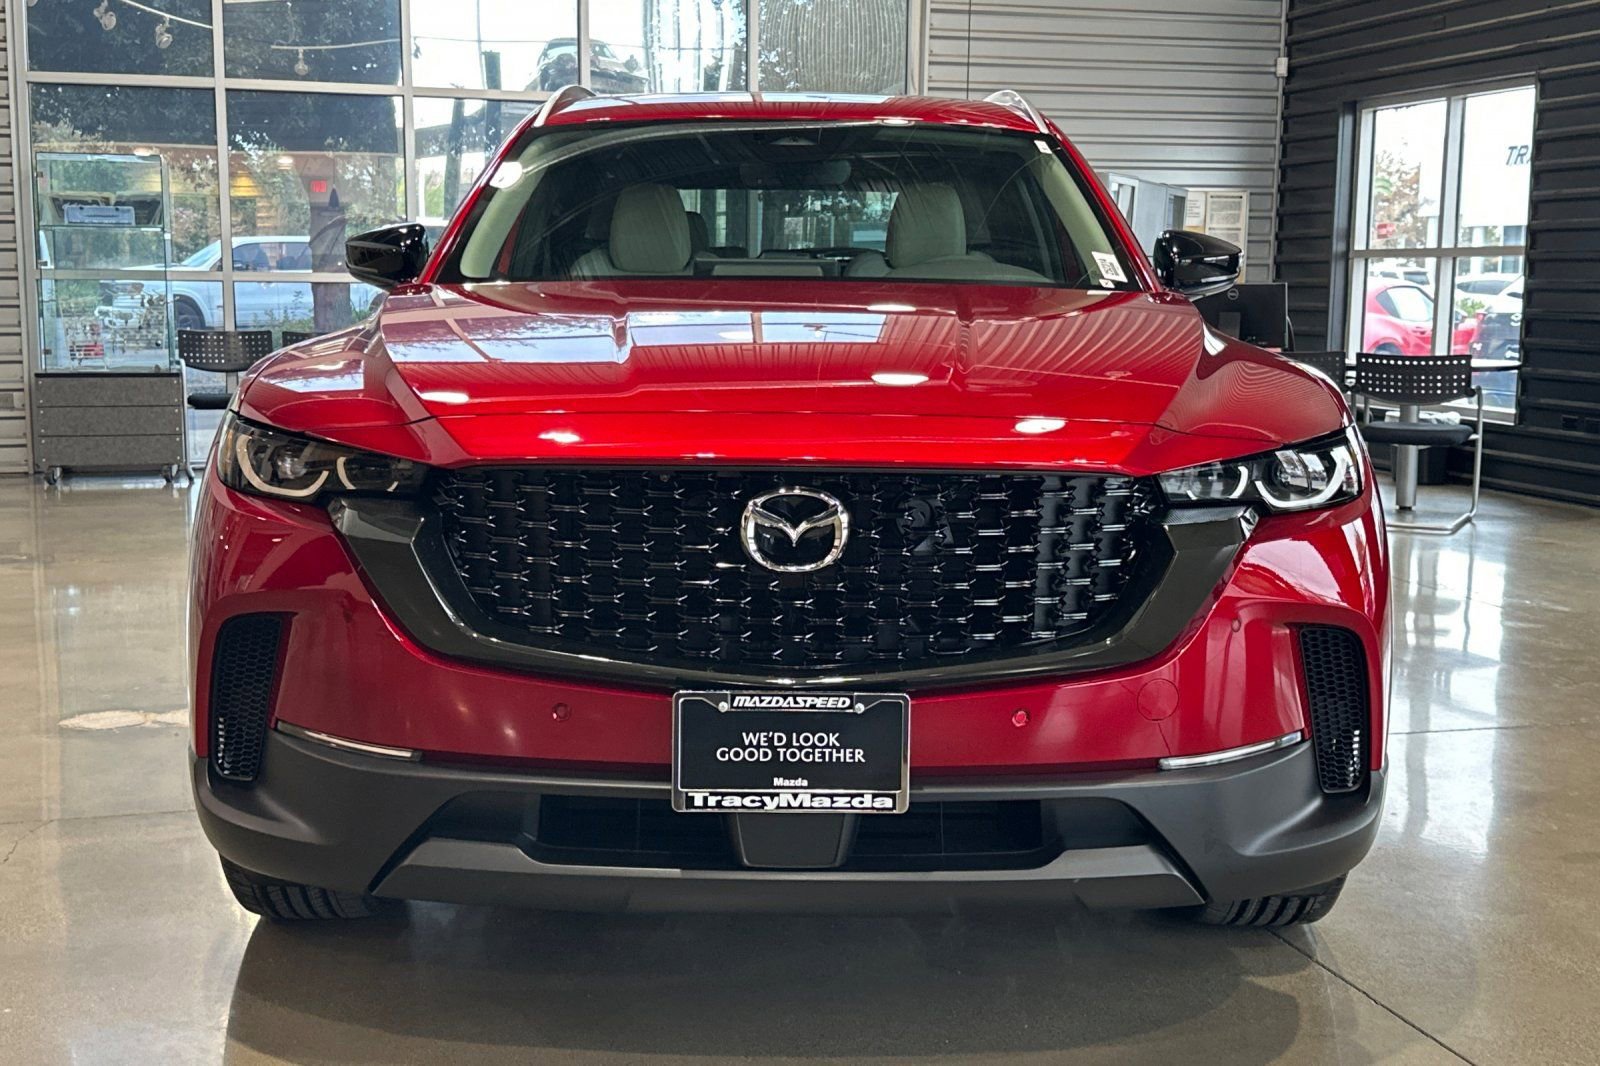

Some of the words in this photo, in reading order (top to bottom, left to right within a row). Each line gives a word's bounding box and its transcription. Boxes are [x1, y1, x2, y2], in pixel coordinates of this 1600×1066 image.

[1506, 145, 1531, 165] TR
[732, 695, 851, 709] MAZDASPEED
[742, 731, 787, 747] WE'D
[792, 732, 841, 747] LOOK
[716, 747, 773, 762] GOOD
[776, 748, 866, 763] TOGETHER
[773, 777, 809, 787] Mazda
[687, 792, 893, 810] TracyMazda
